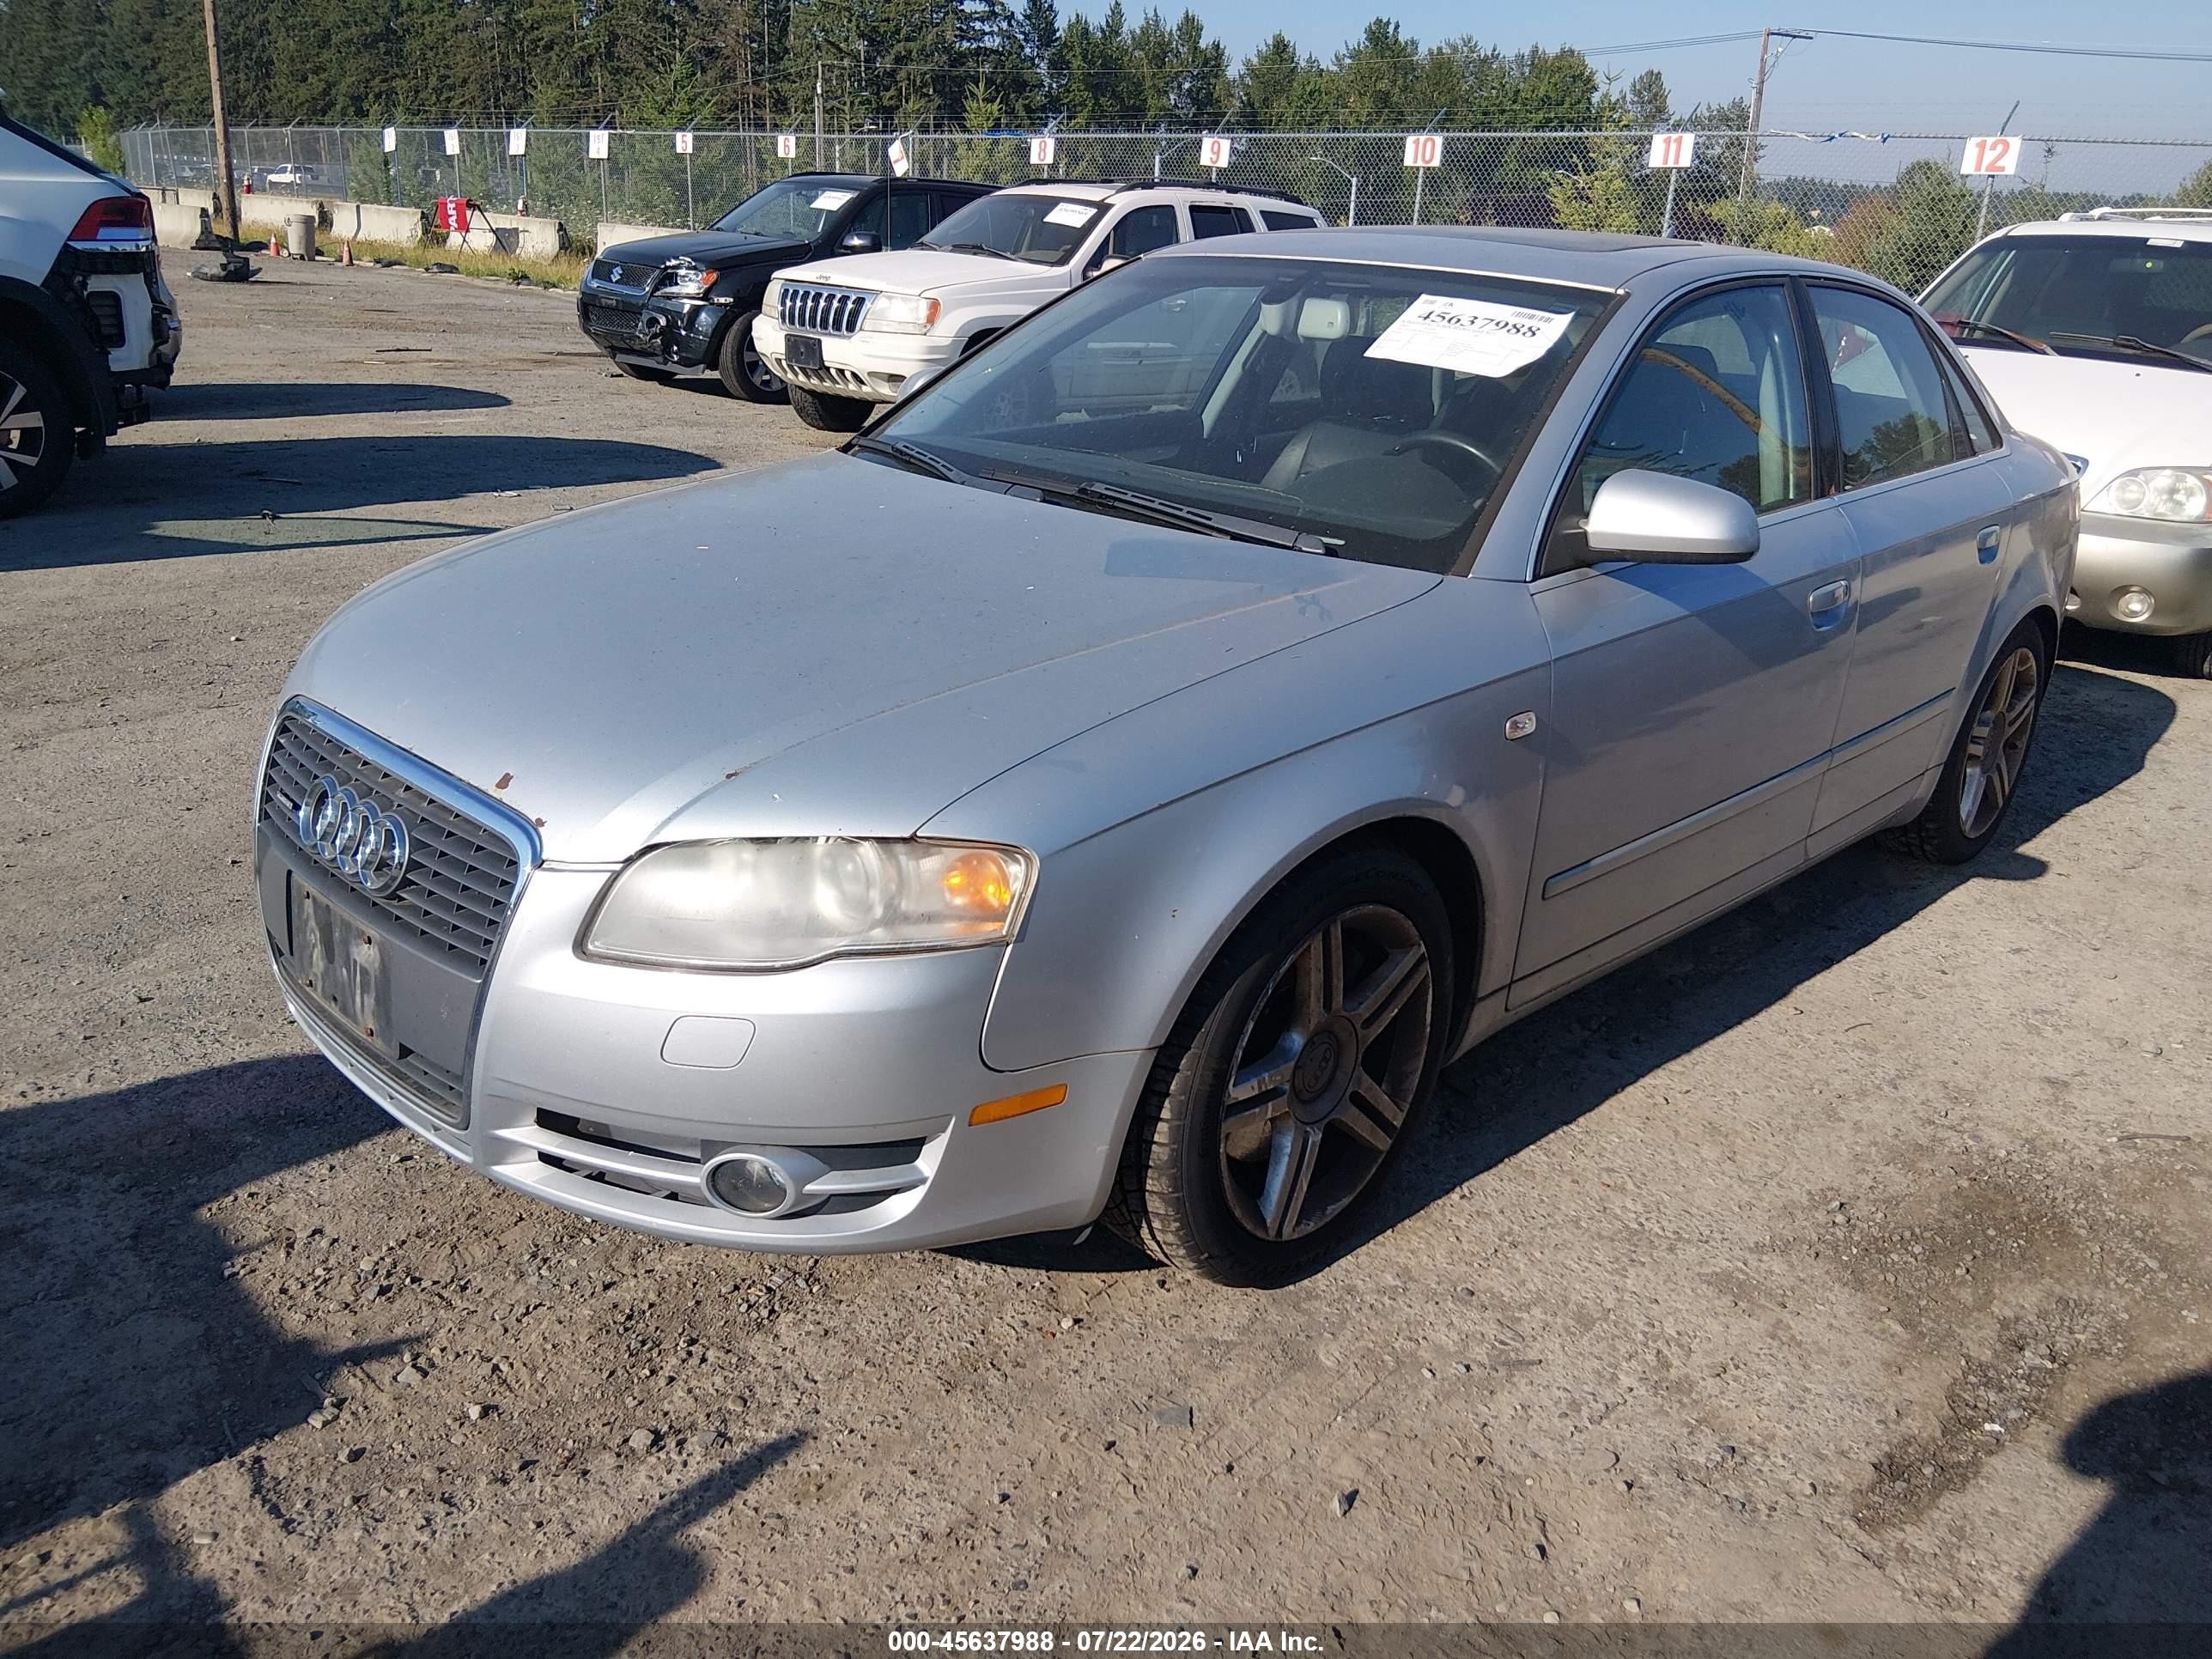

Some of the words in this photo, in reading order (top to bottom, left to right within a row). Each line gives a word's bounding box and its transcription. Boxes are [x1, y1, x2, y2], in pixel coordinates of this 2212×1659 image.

[681, 134, 688, 152] 5
[783, 137, 791, 156] 6
[1037, 139, 1048, 162] 8
[1209, 139, 1221, 165] 9
[1411, 137, 1437, 165] 10
[1662, 135, 1684, 166] 11
[1973, 138, 2010, 173] 12
[1418, 309, 1541, 338] 45637988
